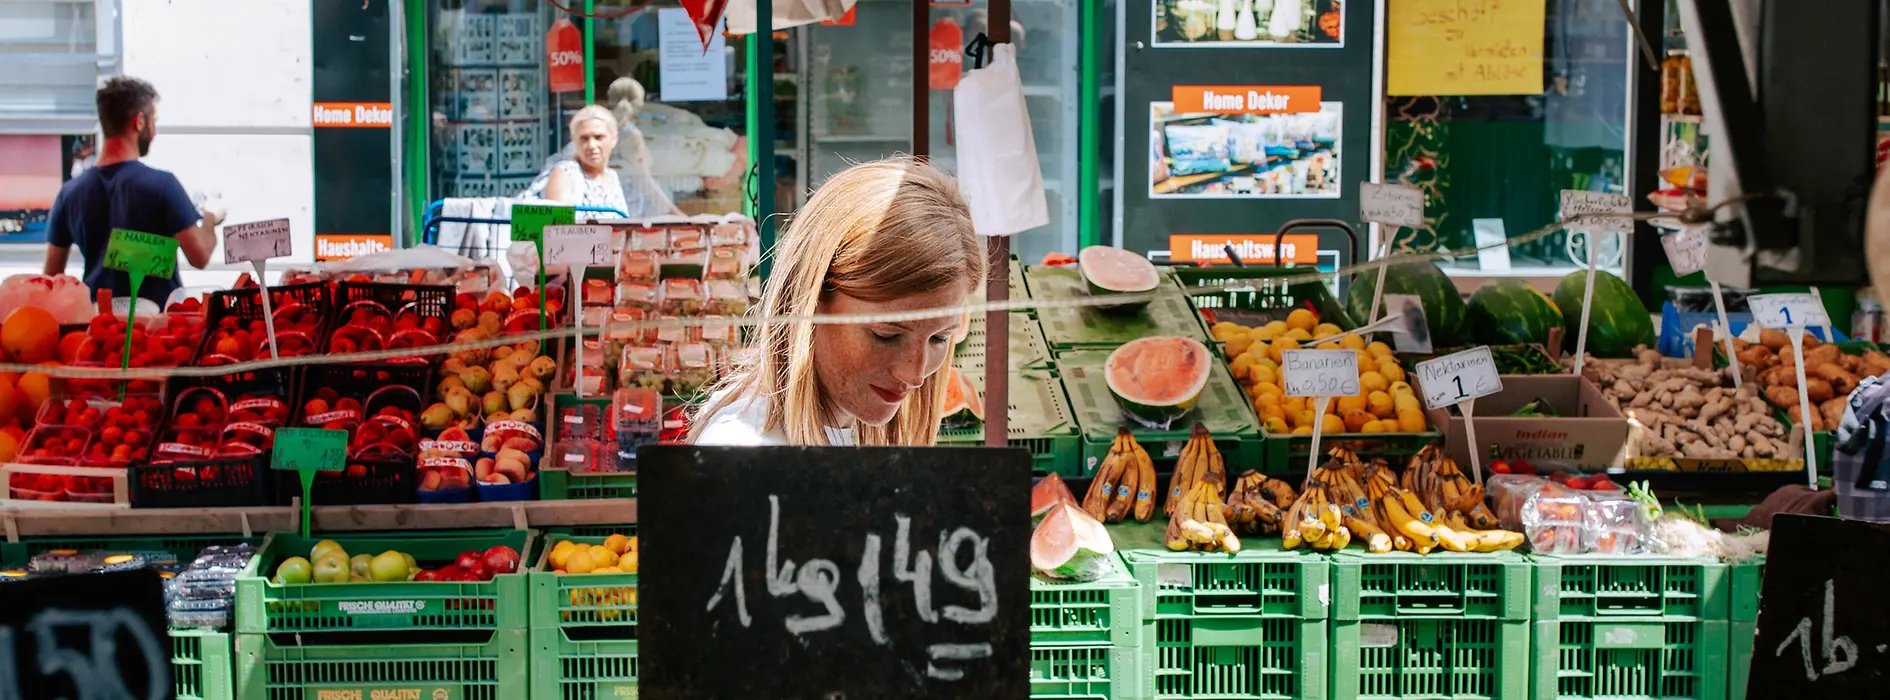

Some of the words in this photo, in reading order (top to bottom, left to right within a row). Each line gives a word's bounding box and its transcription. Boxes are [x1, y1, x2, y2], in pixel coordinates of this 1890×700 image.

[550, 50, 583, 67] 50%
[929, 48, 963, 64] 50%
[1203, 90, 1244, 110] Home
[1247, 90, 1290, 110] Dekor
[313, 104, 352, 123] Home
[554, 226, 597, 236] TRAUBEN
[1191, 238, 1297, 259] Hausaltswre
[1424, 356, 1489, 382] Nektarinen
[1452, 374, 1470, 400] 1
[1515, 429, 1569, 440] Indian
